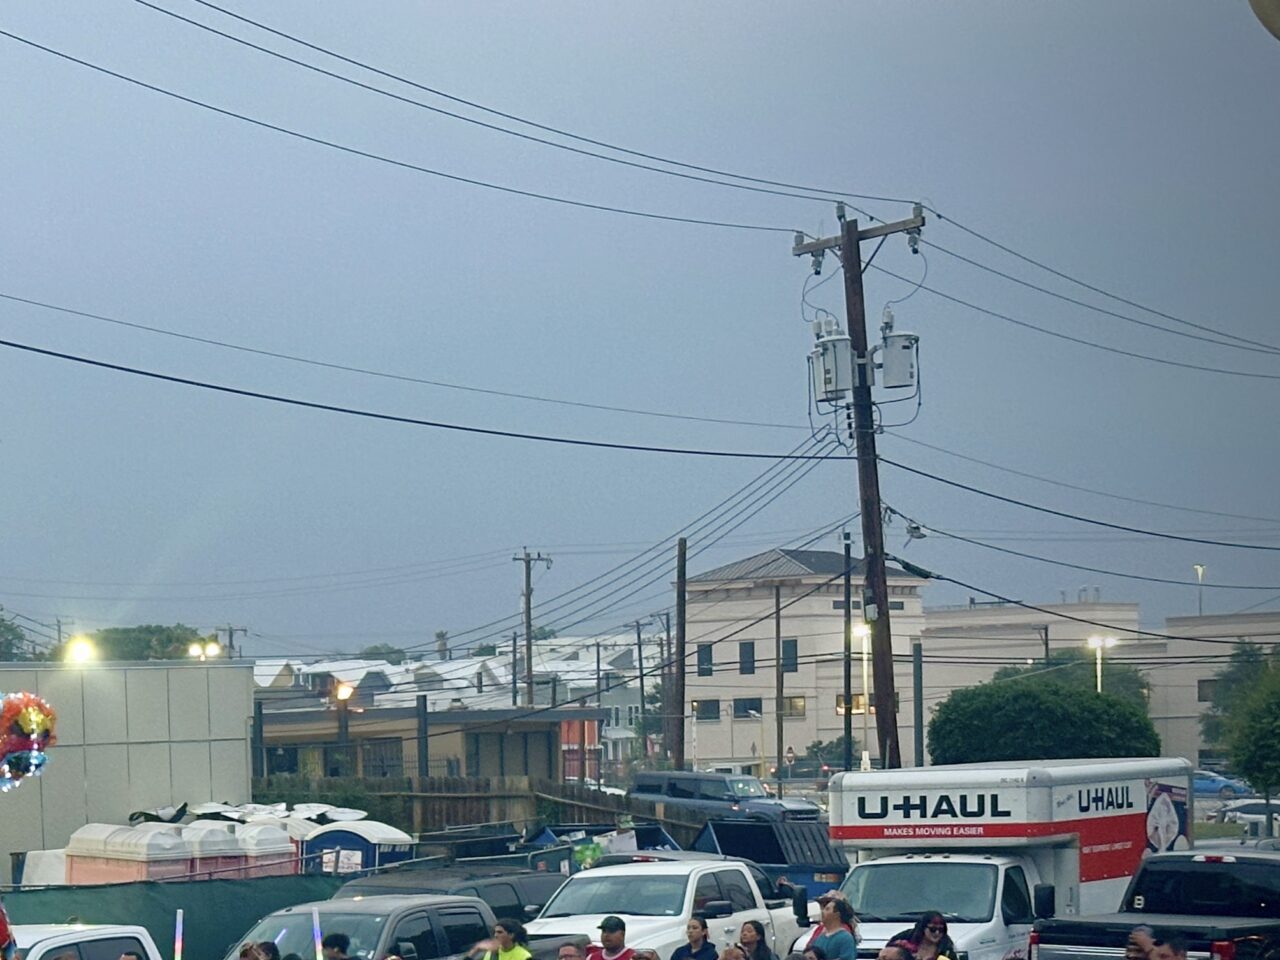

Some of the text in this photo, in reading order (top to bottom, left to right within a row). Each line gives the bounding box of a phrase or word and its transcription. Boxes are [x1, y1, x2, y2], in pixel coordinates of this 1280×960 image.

[857, 793, 1012, 820] U-HAUL
[1078, 785, 1134, 813] U-HAUL
[883, 826, 984, 836] MAKES MOVING EASIER
